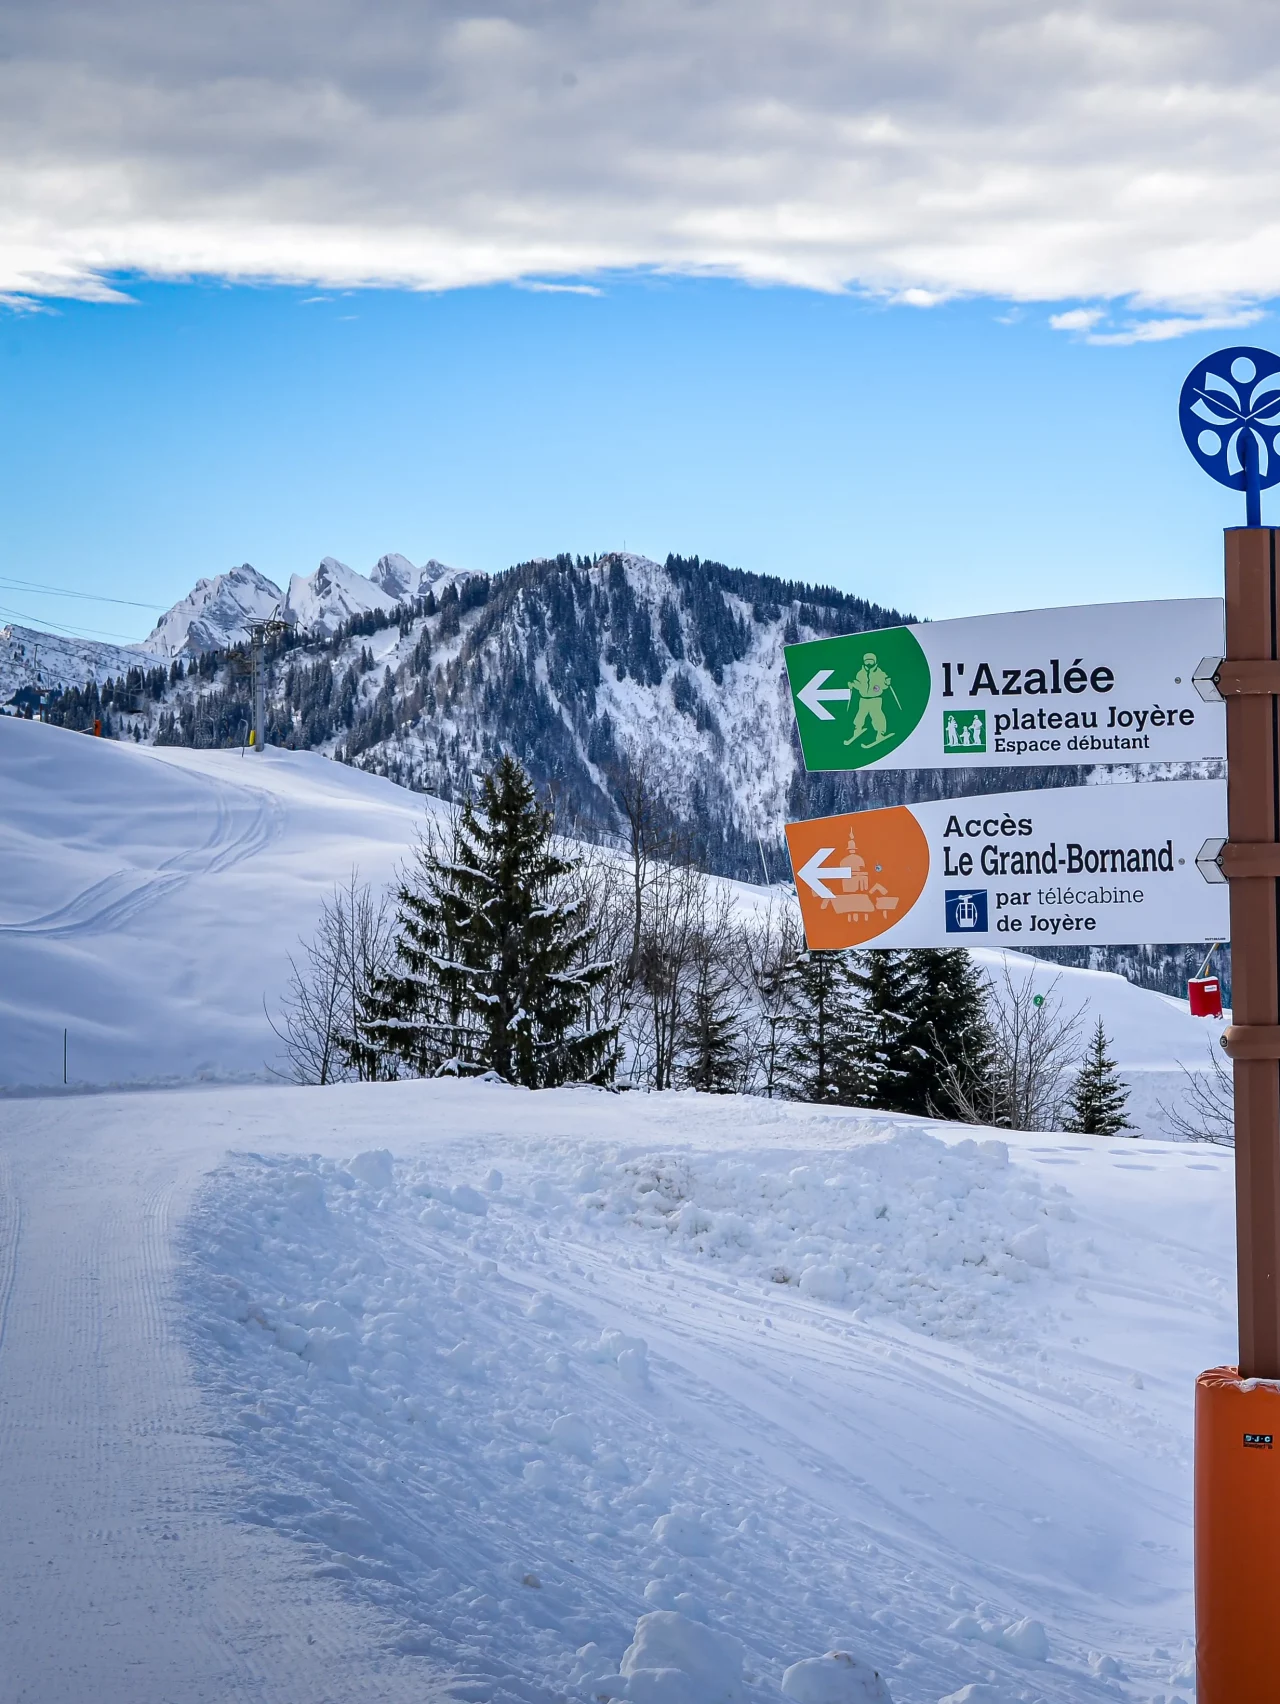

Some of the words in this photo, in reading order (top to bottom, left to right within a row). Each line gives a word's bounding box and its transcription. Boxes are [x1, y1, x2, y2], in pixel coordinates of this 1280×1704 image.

[941, 658, 1115, 697] l'Azalée
[993, 707, 1098, 736] plateau
[1106, 704, 1195, 733] Joyère
[994, 737, 1061, 754] Espace
[1066, 734, 1150, 751] débutant
[942, 813, 1033, 838] Accès
[943, 845, 973, 877] Le
[980, 840, 1174, 876] Grand-Bornand
[995, 892, 1032, 907] par
[1037, 887, 1144, 905] télécabine
[996, 914, 1023, 932] de
[1029, 913, 1097, 935] Joyère
